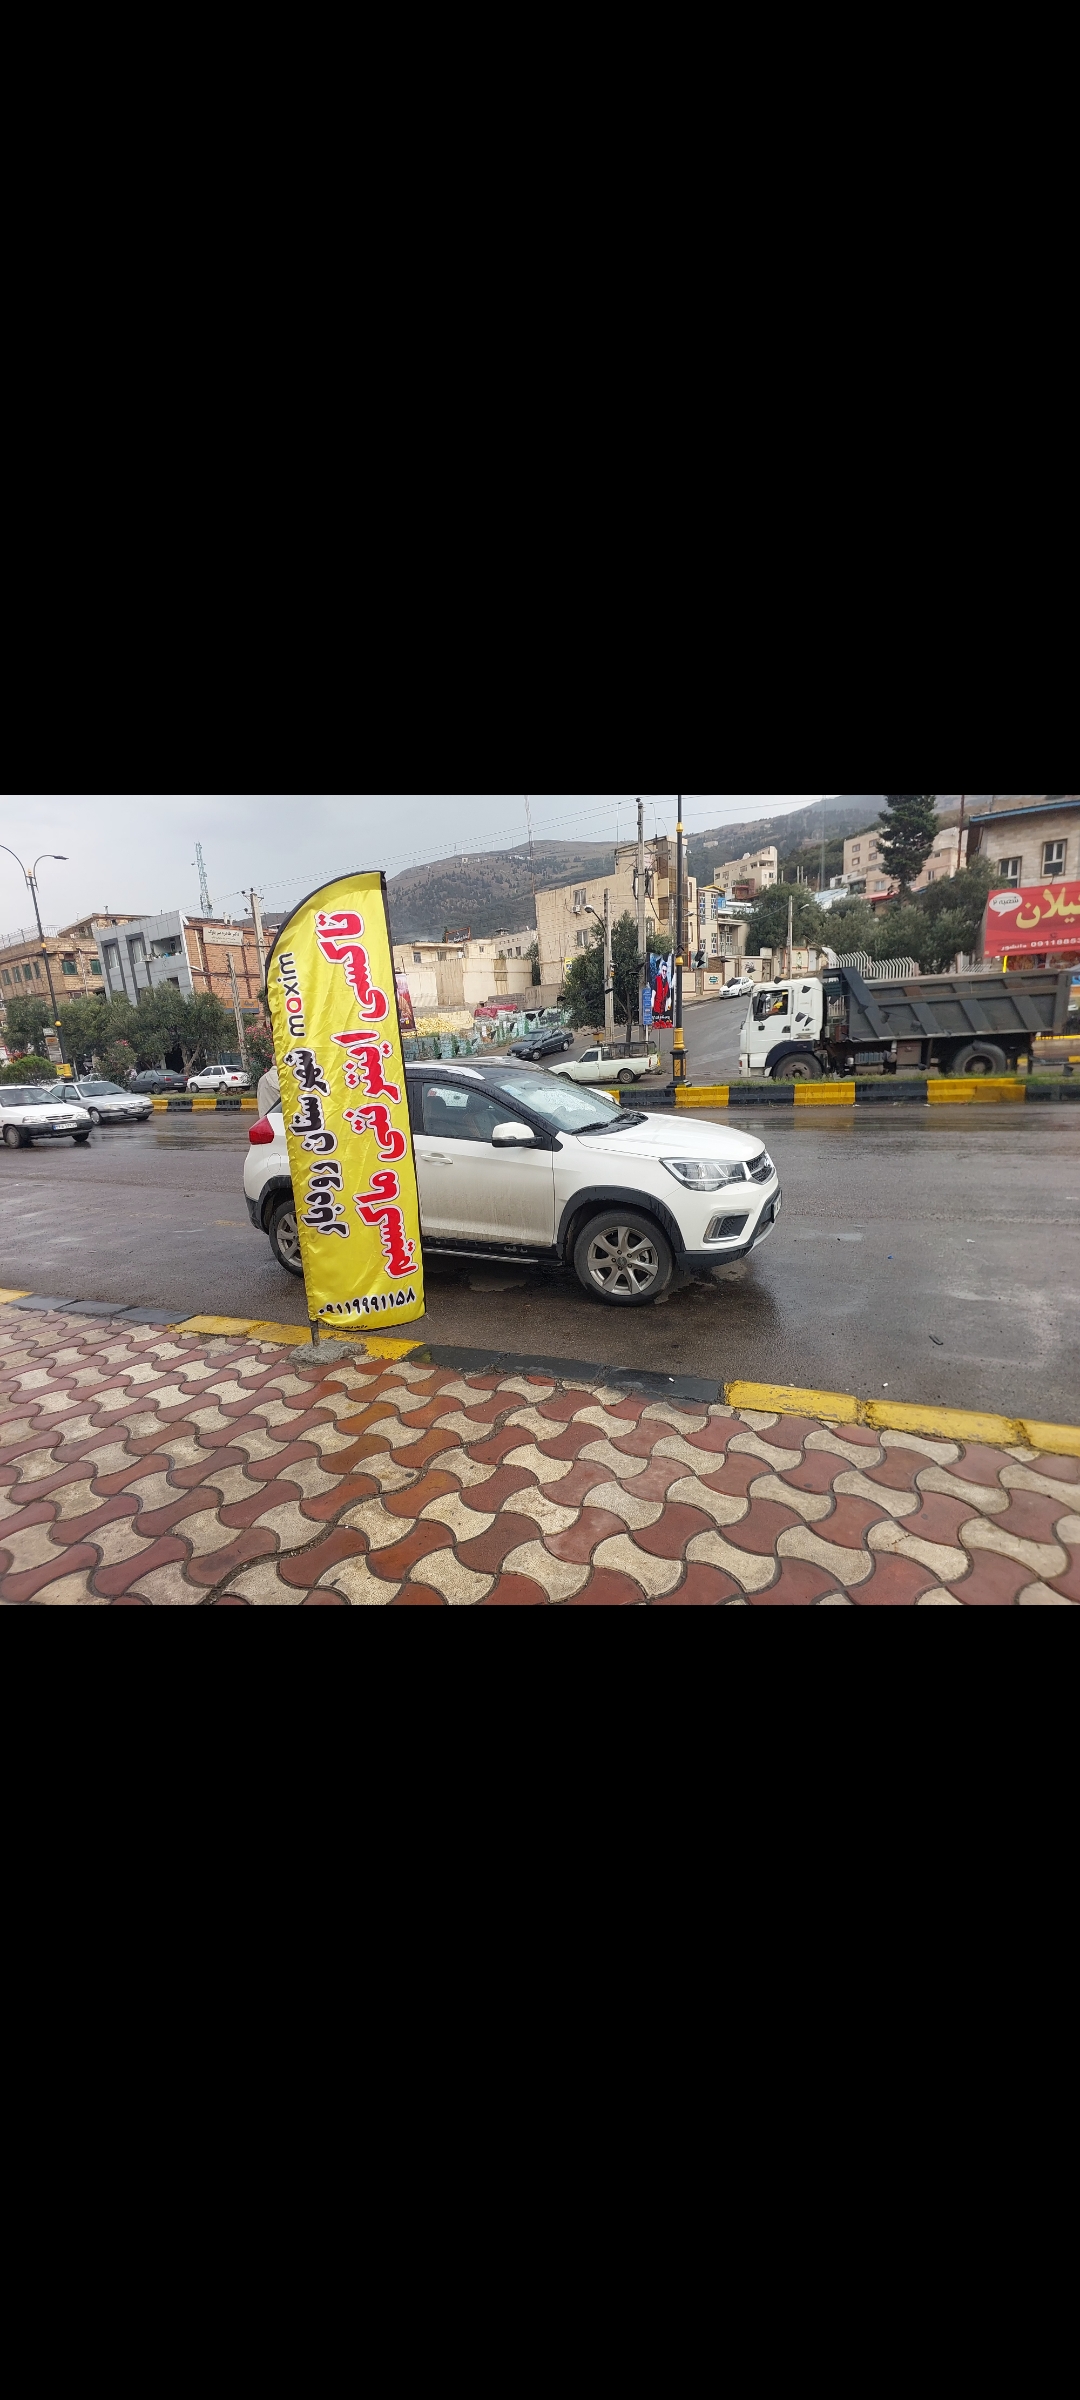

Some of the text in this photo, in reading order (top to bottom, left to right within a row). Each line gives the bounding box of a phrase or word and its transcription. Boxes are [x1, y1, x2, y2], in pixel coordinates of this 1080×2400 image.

[1015, 886, 1080, 929] یلان
[316, 911, 388, 1022] تاکسی
[355, 1170, 418, 1279] ماکسیم
[302, 1160, 350, 1239] رودبار
[318, 1286, 416, 1315] ۰۹۱۱۹۹۹۱۱۵۸
